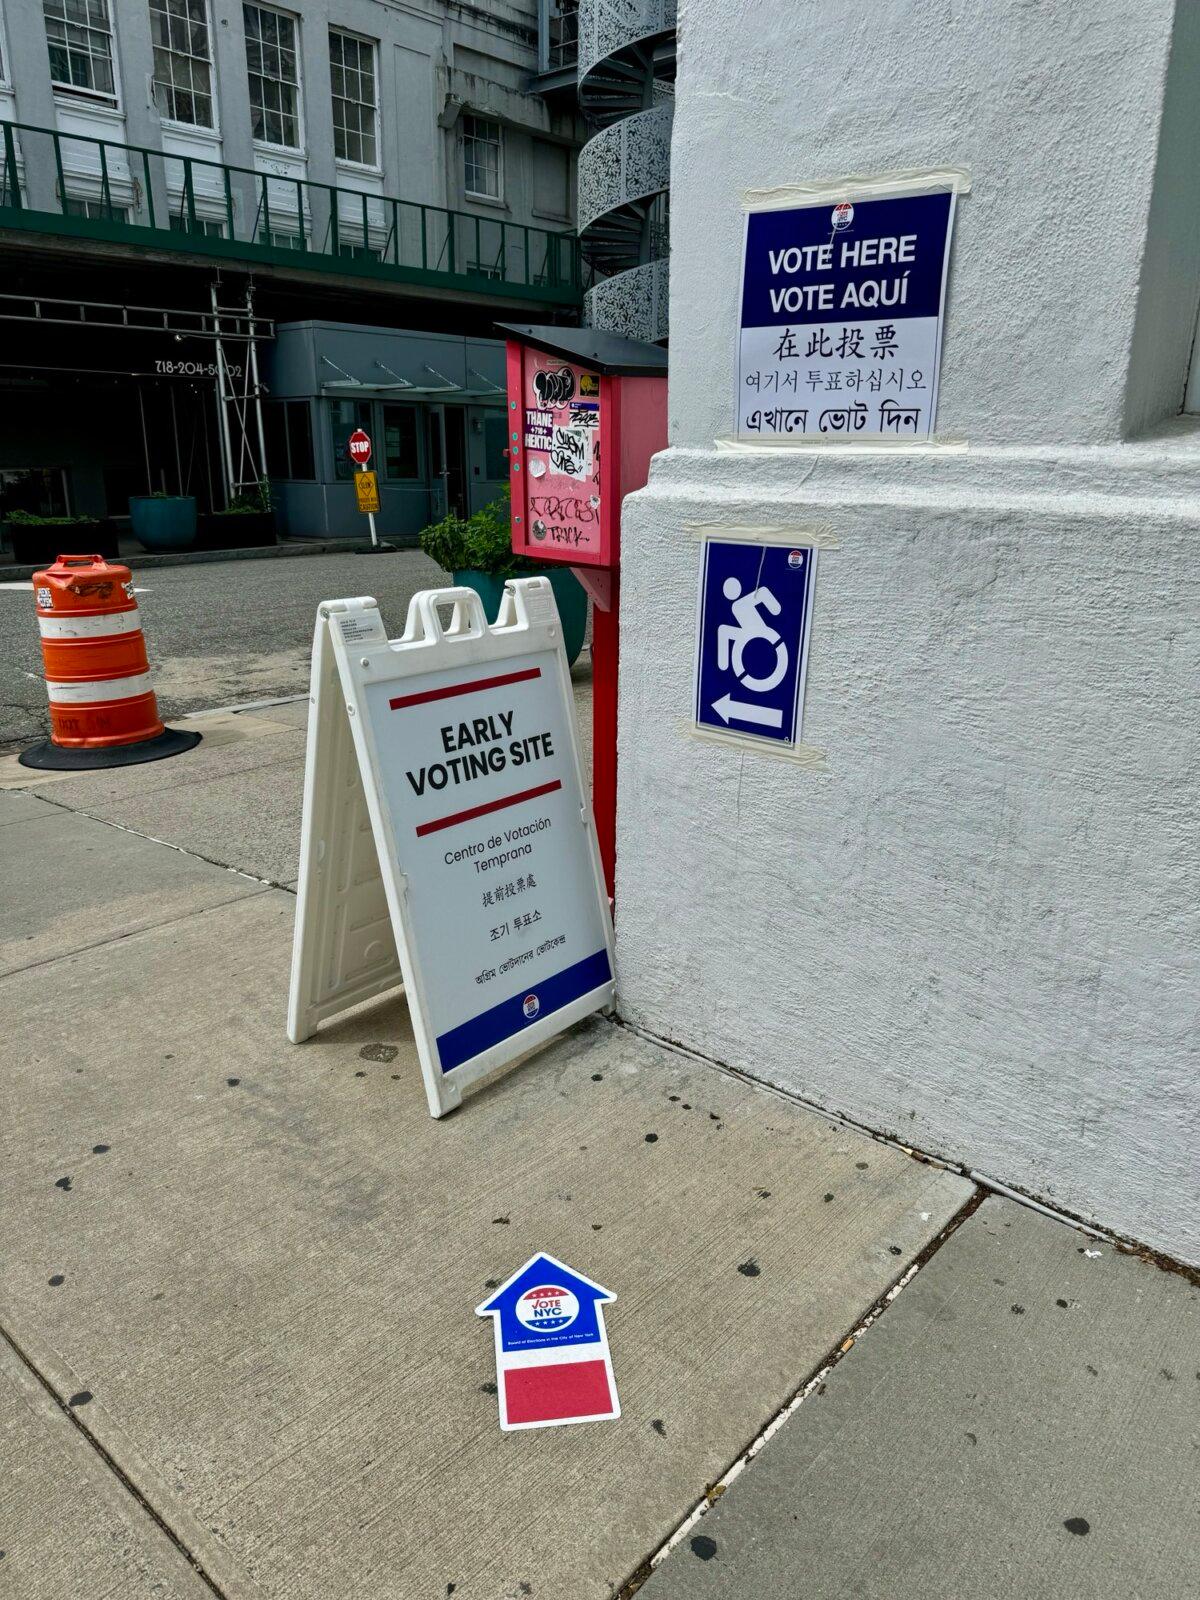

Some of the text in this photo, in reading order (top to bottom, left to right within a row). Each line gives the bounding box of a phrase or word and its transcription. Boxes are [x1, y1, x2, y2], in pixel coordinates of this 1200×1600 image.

[768, 234, 918, 275] VOTE HERE
[769, 270, 911, 313] VOTE AQUÍ
[773, 324, 899, 361] 在此投票
[746, 368, 927, 393] 여기서 투표하십시오
[526, 411, 553, 427] THANE
[746, 399, 921, 434] এখানে ভোট দিন
[351, 441, 369, 453] STOP
[441, 710, 514, 753] EARLY
[405, 732, 554, 796] VOTING SITE
[444, 818, 552, 865] Centro de Votación
[474, 843, 532, 874] Temprana
[482, 873, 537, 907] 提前投票處
[490, 909, 543, 942] 조기 투표소
[531, 1299, 561, 1309] VOTE
[534, 1307, 563, 1318] NYC
